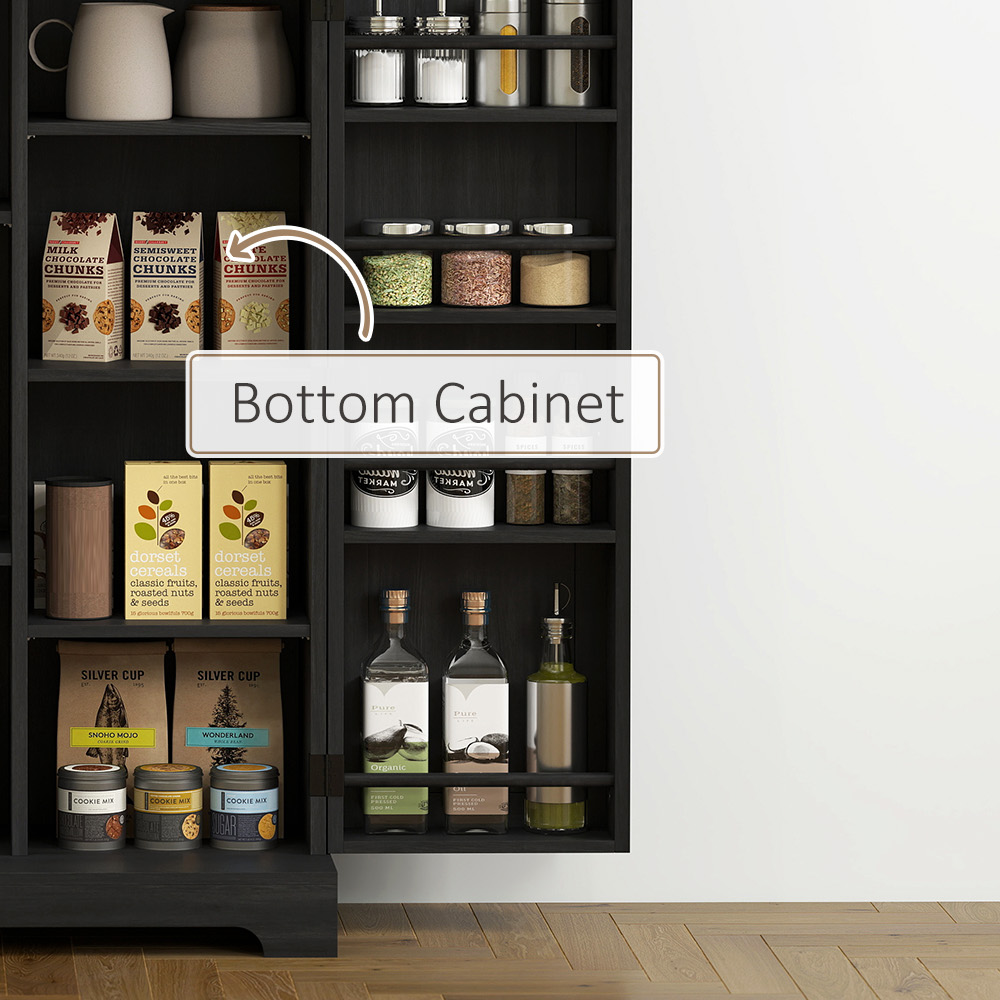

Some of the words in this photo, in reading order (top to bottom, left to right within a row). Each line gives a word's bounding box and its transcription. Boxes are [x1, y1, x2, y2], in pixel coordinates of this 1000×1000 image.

[44, 264, 103, 275] CHUNKS
[133, 264, 196, 274] CHUNKS
[224, 264, 287, 274] CHUNKS
[130, 551, 181, 562] dorset
[215, 551, 266, 562] dorset
[130, 564, 187, 576] cereals
[215, 564, 272, 576] cereals
[167, 579, 198, 588] fruits,
[252, 579, 282, 588] fruits,
[130, 598, 139, 606] &
[215, 598, 224, 606] &
[81, 670, 118, 680] SILVER
[122, 670, 144, 680] CUP
[198, 671, 234, 680] SILVER
[238, 671, 260, 681] CUP
